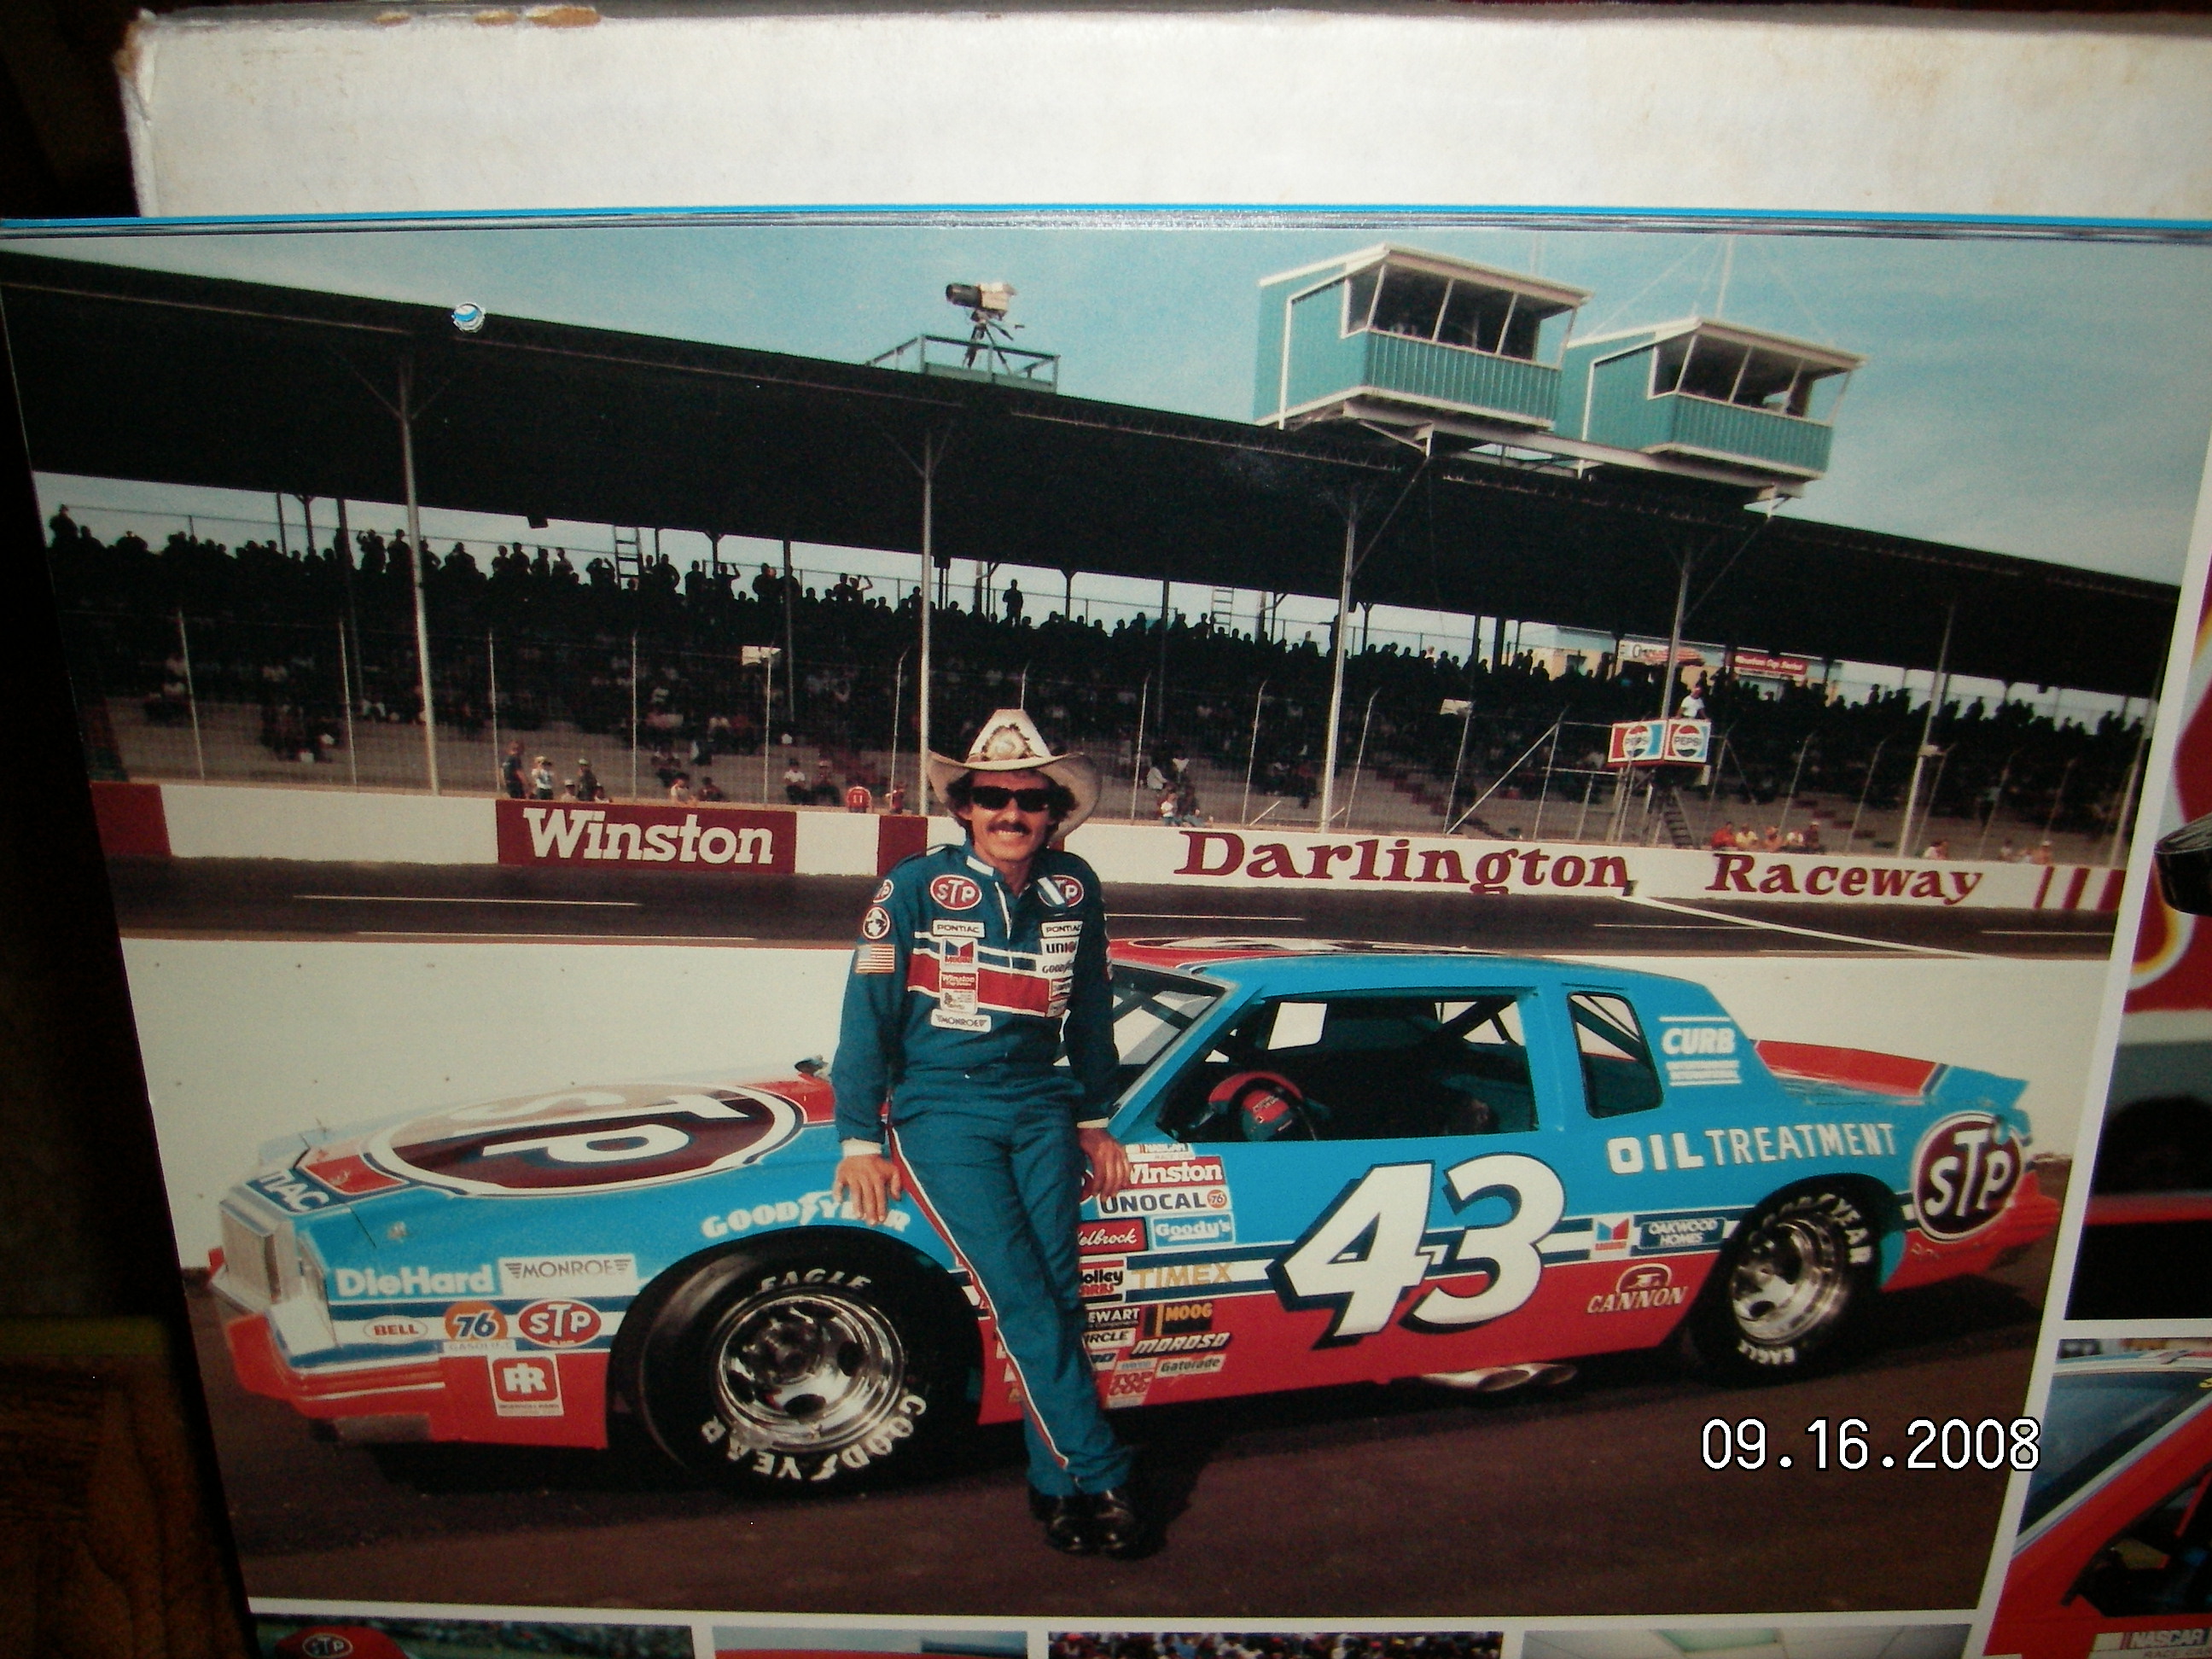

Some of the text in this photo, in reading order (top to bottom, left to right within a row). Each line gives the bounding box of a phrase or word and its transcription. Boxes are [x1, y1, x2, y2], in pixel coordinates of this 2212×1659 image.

[523, 807, 774, 864] Winston
[1173, 830, 1983, 905] Darlington Raceway
[937, 880, 976, 903] STP
[937, 924, 981, 934] PONTIAC
[940, 1017, 981, 1027] MONROE
[1662, 1027, 1736, 1055] CURB
[1606, 1122, 1898, 1174] OIL TREATMENT
[1925, 1129, 2011, 1217] STP
[701, 1190, 911, 1237] GOODYER
[1101, 1192, 1224, 1214] UNOCAL 76
[1077, 1227, 1138, 1246] elbrock
[1649, 1219, 1719, 1235] OAKWOOD
[1283, 1154, 1565, 1337] 43
[335, 1263, 495, 1297] DieHard
[521, 1259, 613, 1279] MONROE
[1080, 1269, 1124, 1286] olley
[1131, 1262, 1232, 1289] TIMEX
[1587, 1285, 1689, 1313] CANNON
[528, 1303, 592, 1338] STP
[1087, 1307, 1140, 1324] EWART
[1166, 1302, 1214, 1322] MOOG
[373, 1324, 419, 1336] BELL
[455, 1311, 498, 1340] 76
[1082, 1330, 1129, 1343] IRCLE
[1161, 1357, 1221, 1373] Gatorade
